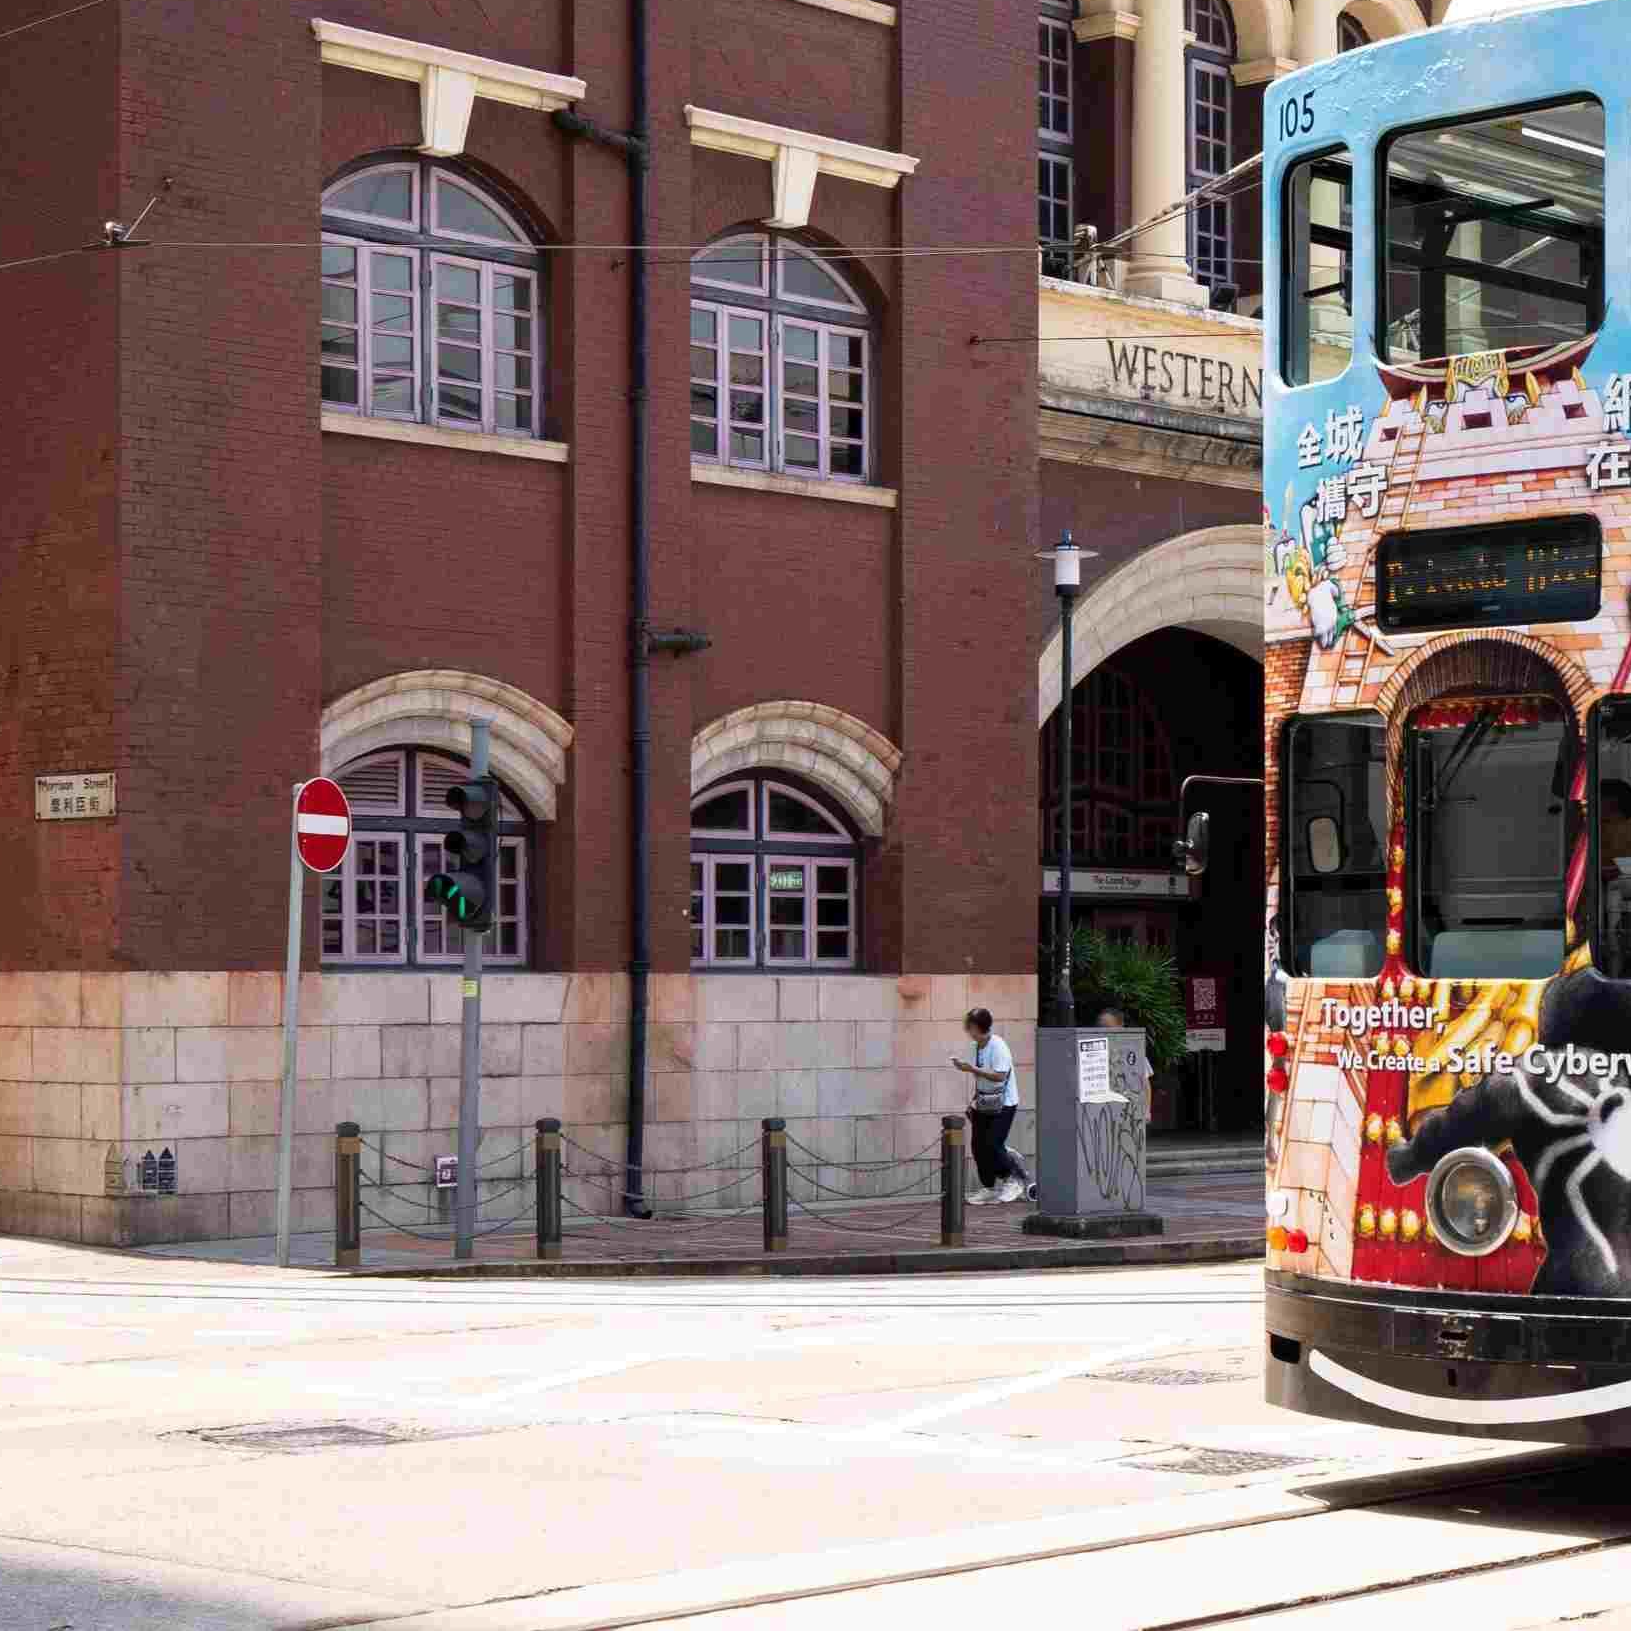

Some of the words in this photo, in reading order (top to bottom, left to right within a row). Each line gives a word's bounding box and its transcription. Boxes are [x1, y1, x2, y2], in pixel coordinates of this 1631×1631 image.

[1278, 89, 1316, 141] 105
[1106, 339, 1263, 409] WESTERN
[1321, 998, 1448, 1034] Together,
[1335, 1049, 1367, 1071] We
[1368, 1050, 1425, 1072] Create
[1430, 1056, 1443, 1072] a
[1446, 1043, 1515, 1075] Safe
